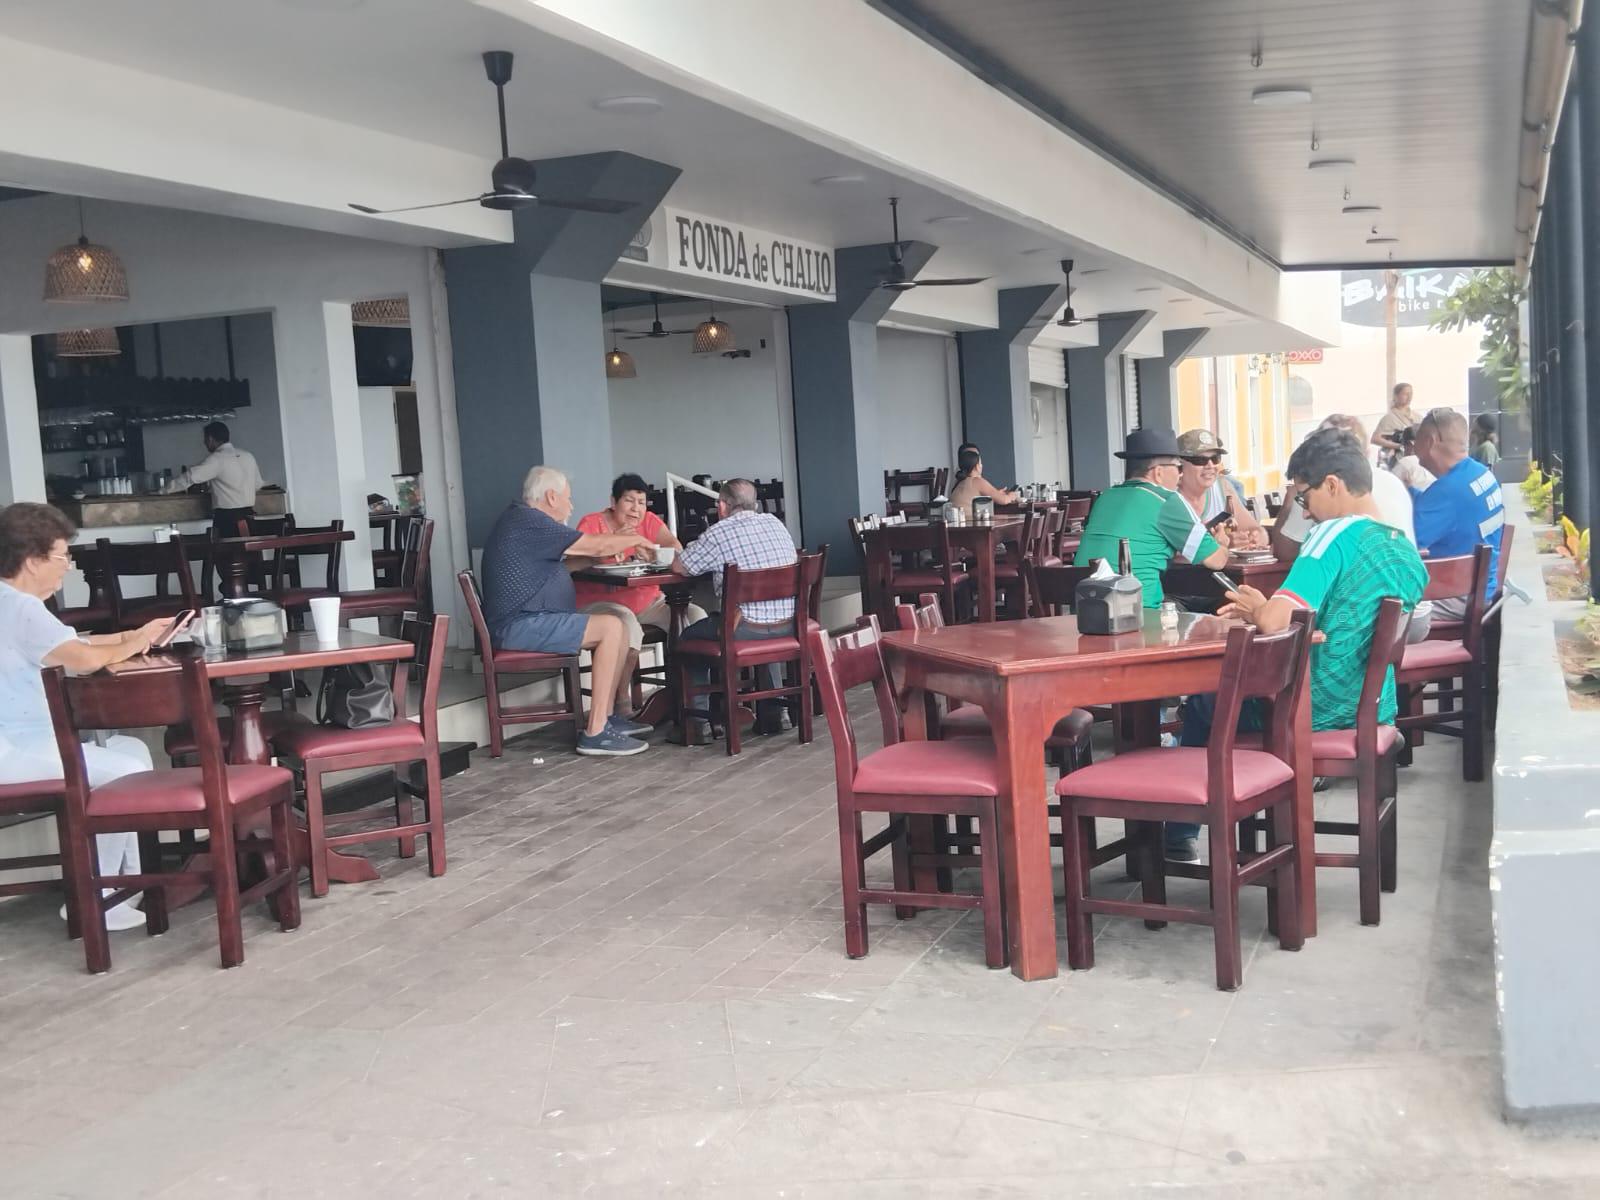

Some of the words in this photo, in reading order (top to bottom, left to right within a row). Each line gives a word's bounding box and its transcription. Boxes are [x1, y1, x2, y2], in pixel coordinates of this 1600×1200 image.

[675, 215, 751, 280] FONDA
[752, 243, 769, 283] de
[771, 240, 832, 293] CHALIO
[1399, 299, 1430, 312] bike
[1288, 350, 1322, 361] OXXO
